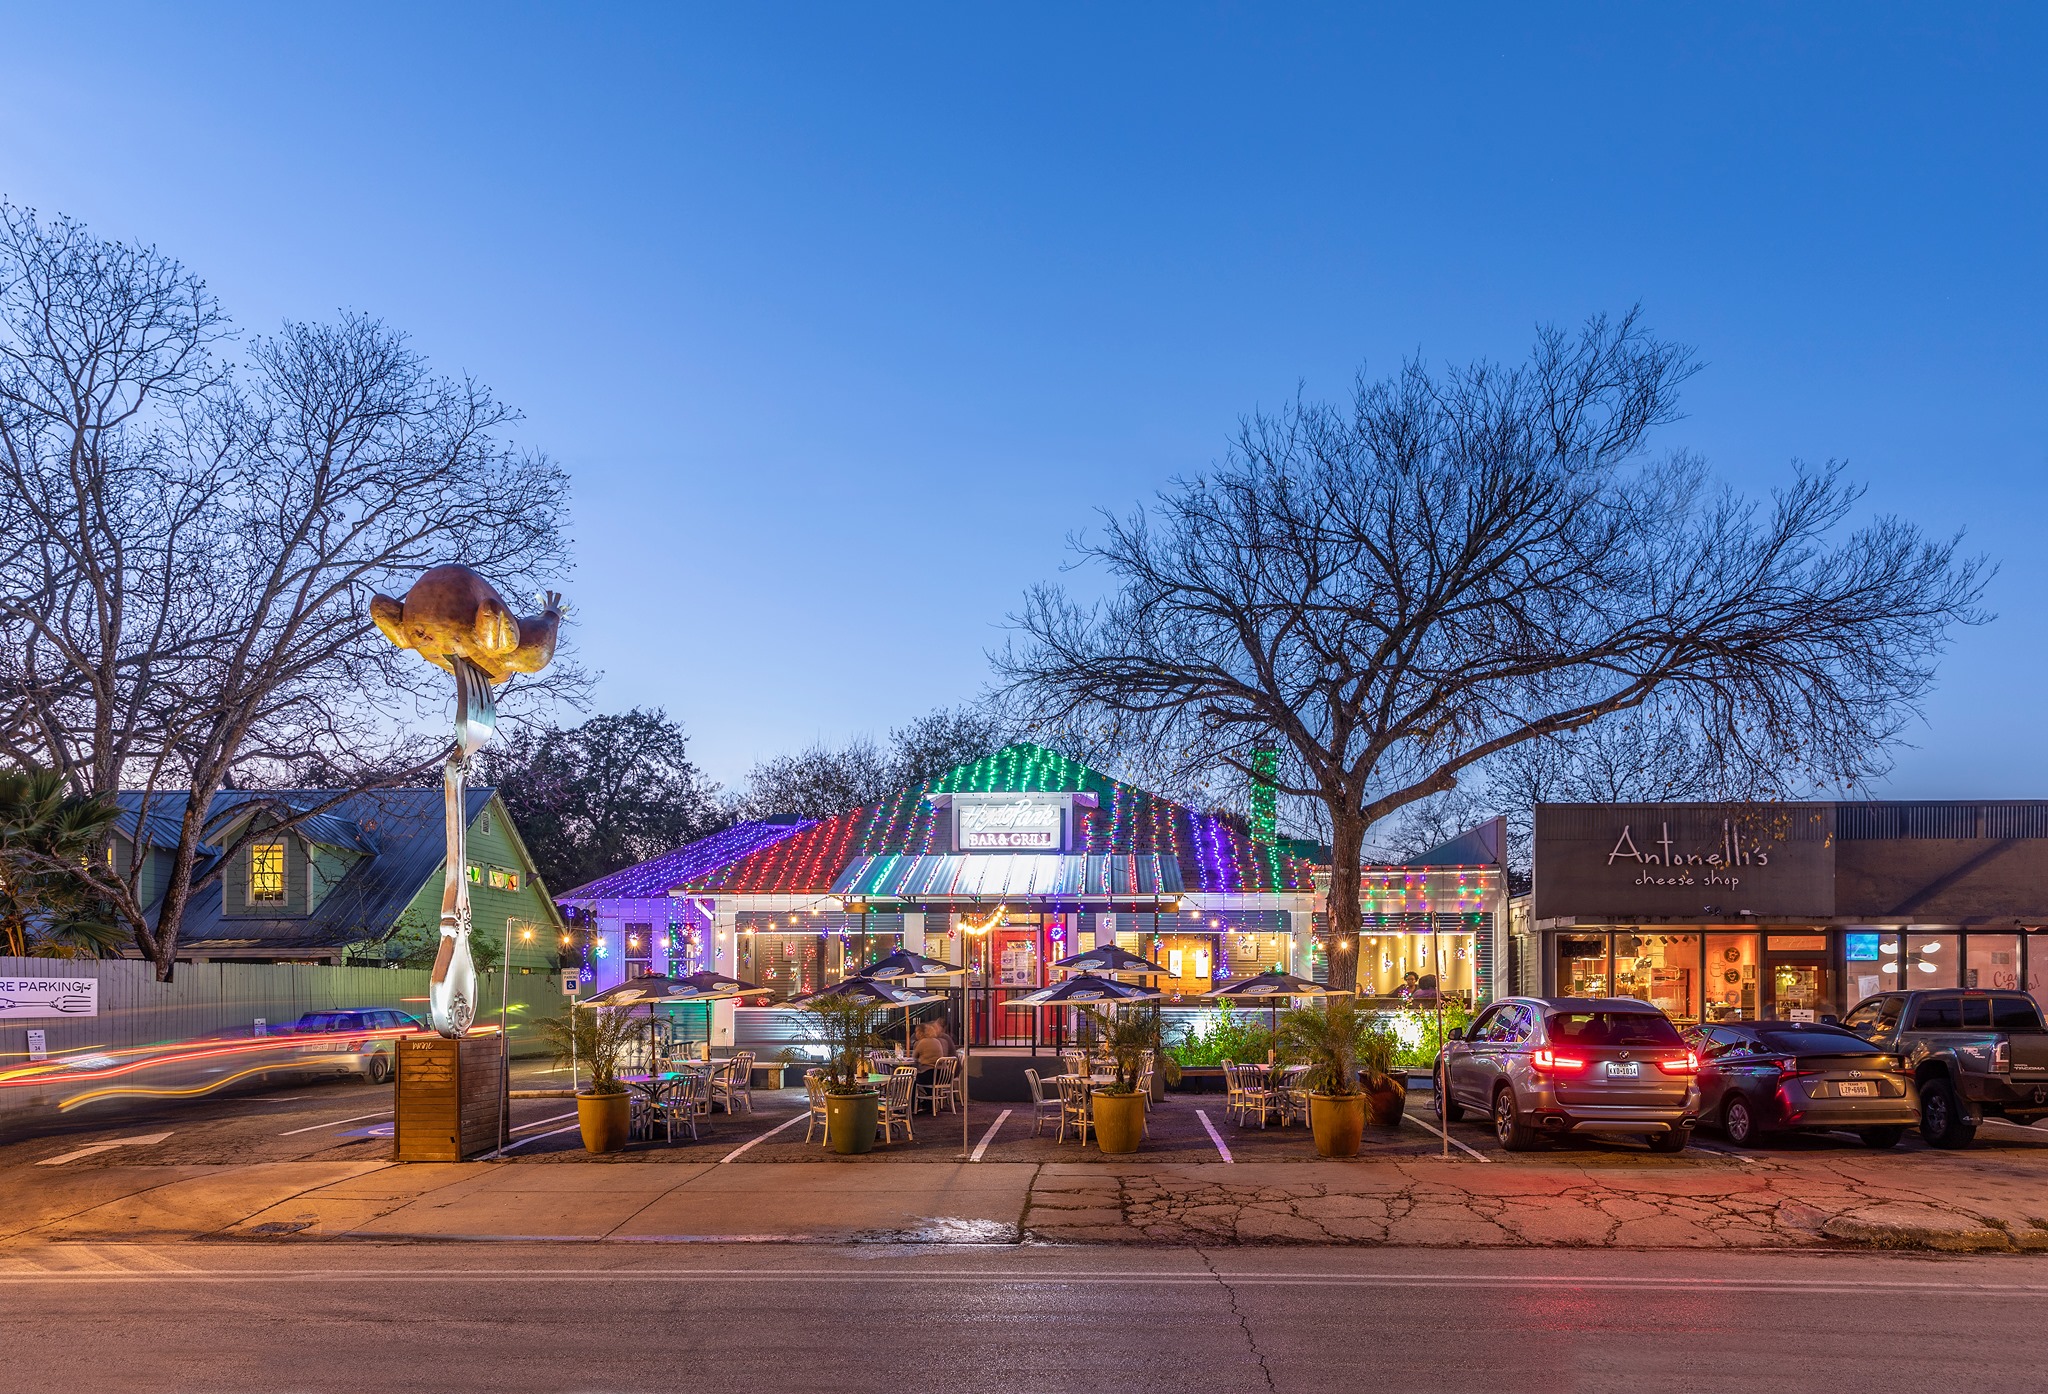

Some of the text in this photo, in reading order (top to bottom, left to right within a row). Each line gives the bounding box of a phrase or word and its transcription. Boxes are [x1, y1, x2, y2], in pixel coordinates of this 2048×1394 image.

[962, 799, 1060, 832] Hyde Park
[969, 833, 1051, 846] BAR & GRILL
[1608, 819, 1768, 867] Antonelli's
[1635, 870, 1739, 891] cheese shop
[19, 981, 82, 992] PARKING
